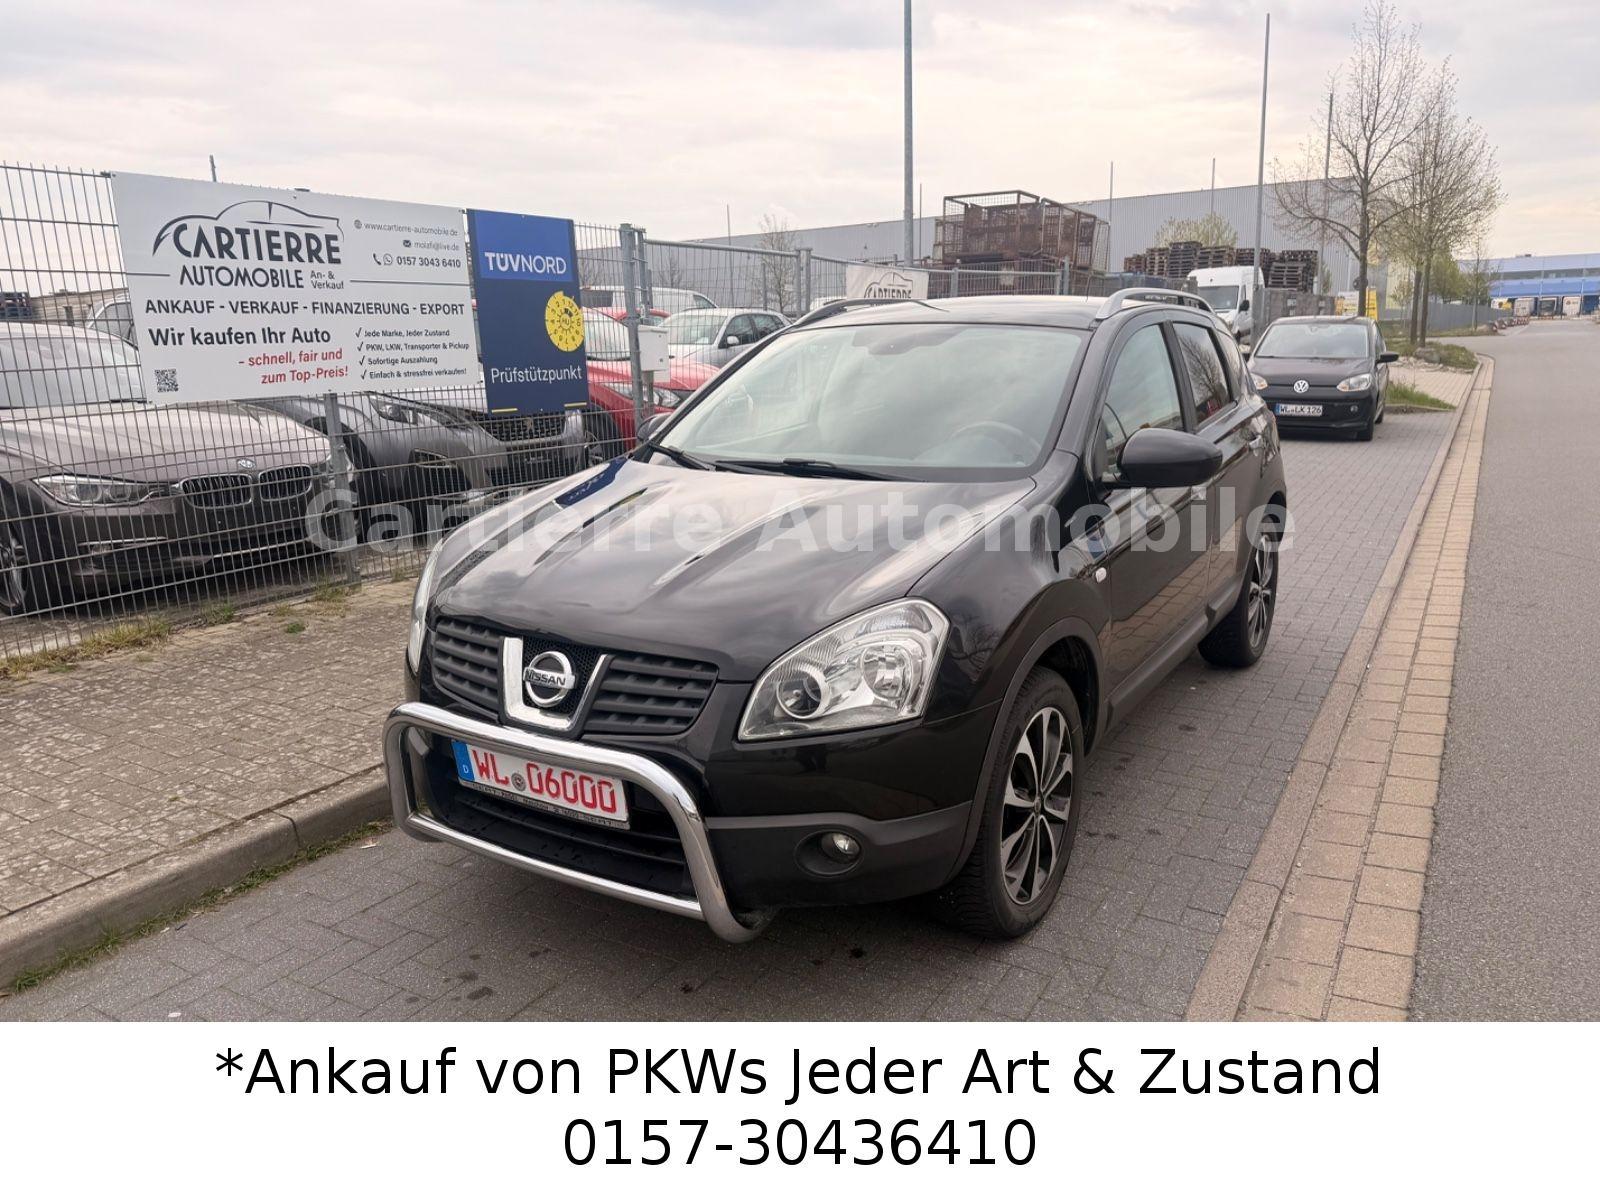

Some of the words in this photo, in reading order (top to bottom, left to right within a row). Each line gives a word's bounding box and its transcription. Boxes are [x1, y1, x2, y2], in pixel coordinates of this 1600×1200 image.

[173, 223, 342, 264] CARTIERRE
[397, 256, 417, 266] 0157
[418, 257, 440, 267] 3043
[441, 258, 462, 268] 6410
[180, 265, 304, 289] AUTOMOBILE
[327, 271, 336, 280] &
[310, 280, 345, 290] Verkauf
[145, 299, 214, 314] ANKAUF
[229, 300, 299, 314] VERKAUF
[311, 302, 410, 315] FINANZIERUNG
[420, 303, 465, 315] EXPORT
[148, 327, 185, 346] Wir
[190, 327, 257, 345] kaufen
[261, 326, 286, 344] Ihr
[291, 327, 331, 344] Auto
[364, 329, 380, 337] Jede
[381, 329, 405, 338] Marke,
[406, 329, 423, 337] Jeder
[424, 328, 450, 337] Zustand
[366, 343, 385, 352] PKW,
[385, 343, 403, 352] LKW,
[403, 342, 441, 352] Transporter
[448, 342, 470, 350] Pickup
[248, 350, 296, 367] schnell,
[298, 348, 318, 363] fair
[321, 347, 343, 361] und
[367, 356, 400, 366] Sofortige
[400, 355, 438, 365] Auszahlung
[261, 372, 287, 385] zum
[289, 365, 349, 384] Top-Preis!
[369, 370, 395, 379] Einfach
[403, 369, 434, 379] stressfrei
[434, 367, 467, 377] verkaufen!
[491, 365, 583, 384] Prüfstützpunkt
[526, 668, 566, 686] NISSAN
[472, 750, 510, 785] WL
[526, 761, 617, 814] 06000
